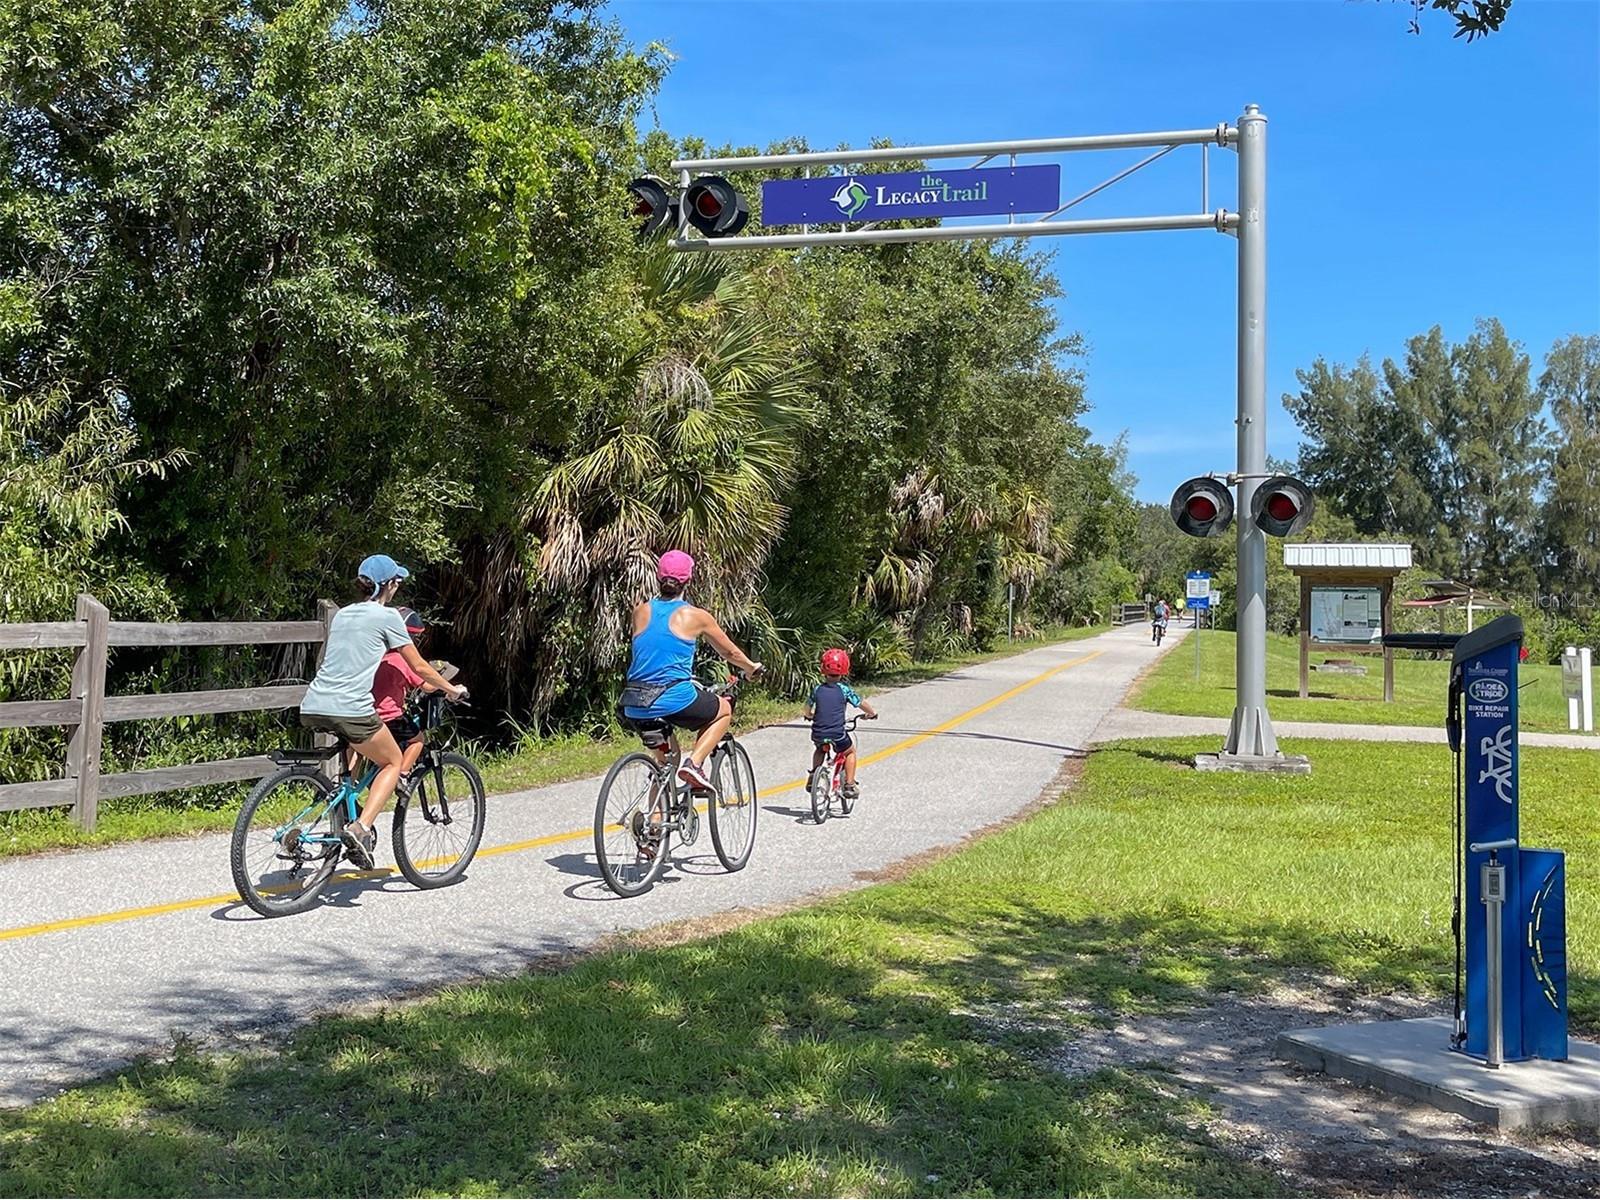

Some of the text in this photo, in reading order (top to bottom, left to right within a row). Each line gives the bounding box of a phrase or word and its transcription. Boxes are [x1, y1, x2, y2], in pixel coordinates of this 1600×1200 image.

[922, 175, 943, 187] the
[876, 181, 988, 206] LEGACY trail
